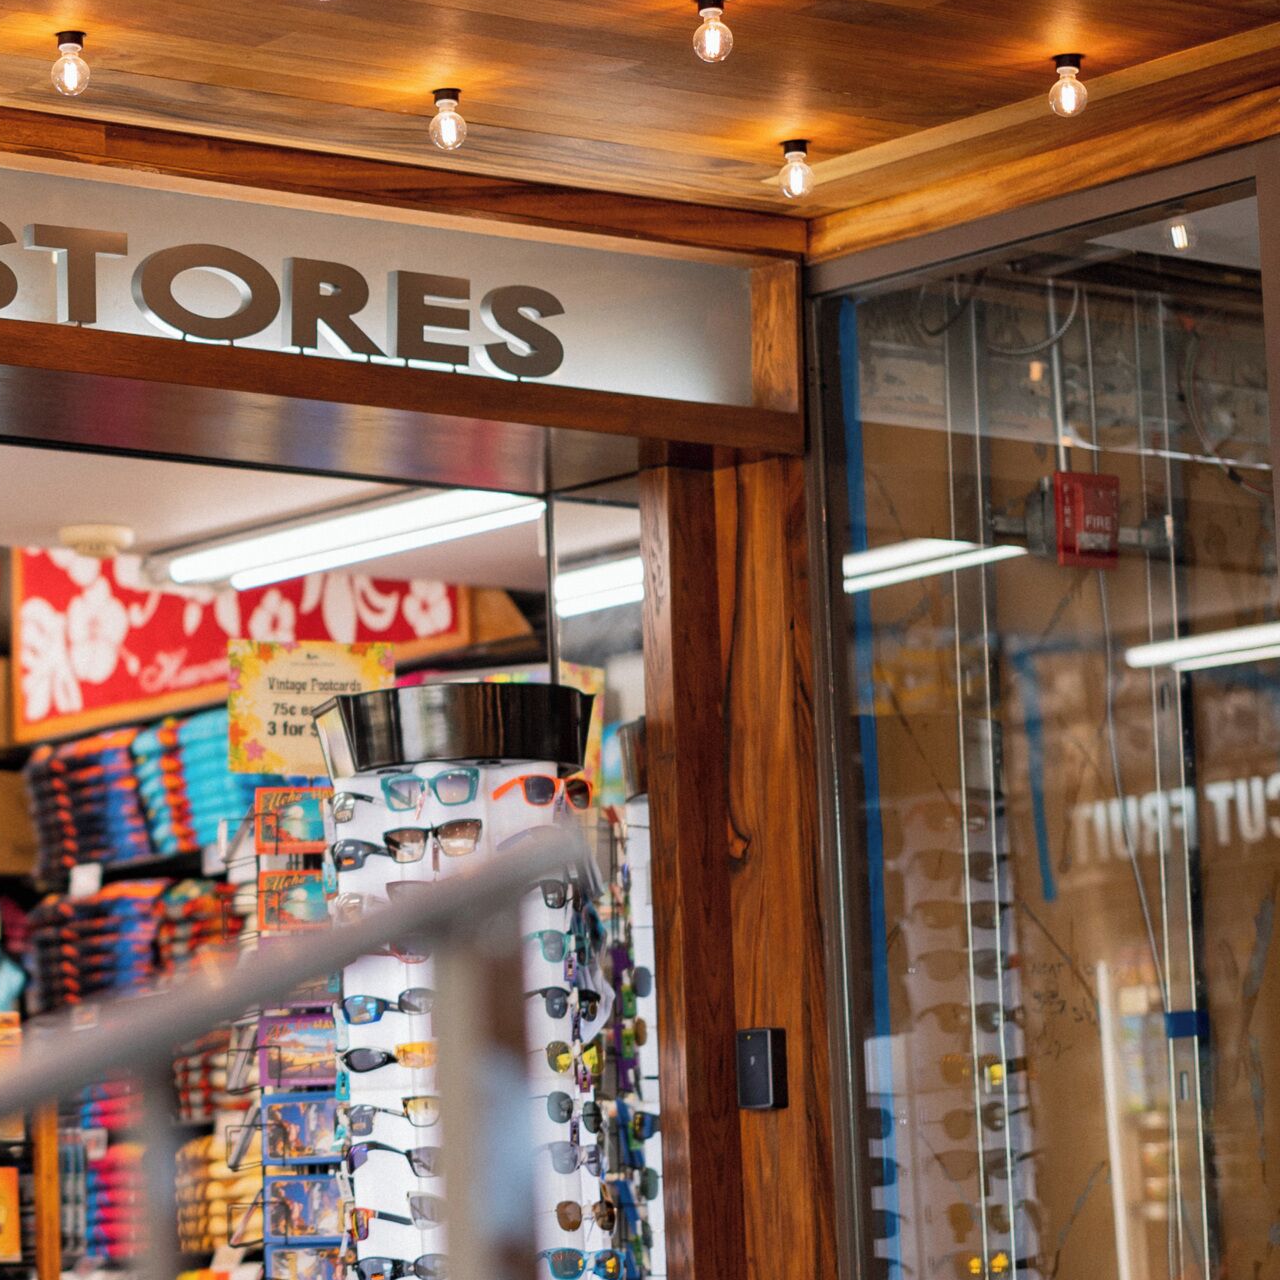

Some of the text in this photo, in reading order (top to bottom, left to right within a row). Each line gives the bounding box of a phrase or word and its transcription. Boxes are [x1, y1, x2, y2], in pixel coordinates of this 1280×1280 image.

[268, 677, 362, 694] Vintage Postcards
[267, 721, 277, 736] 3
[282, 720, 305, 736] for
